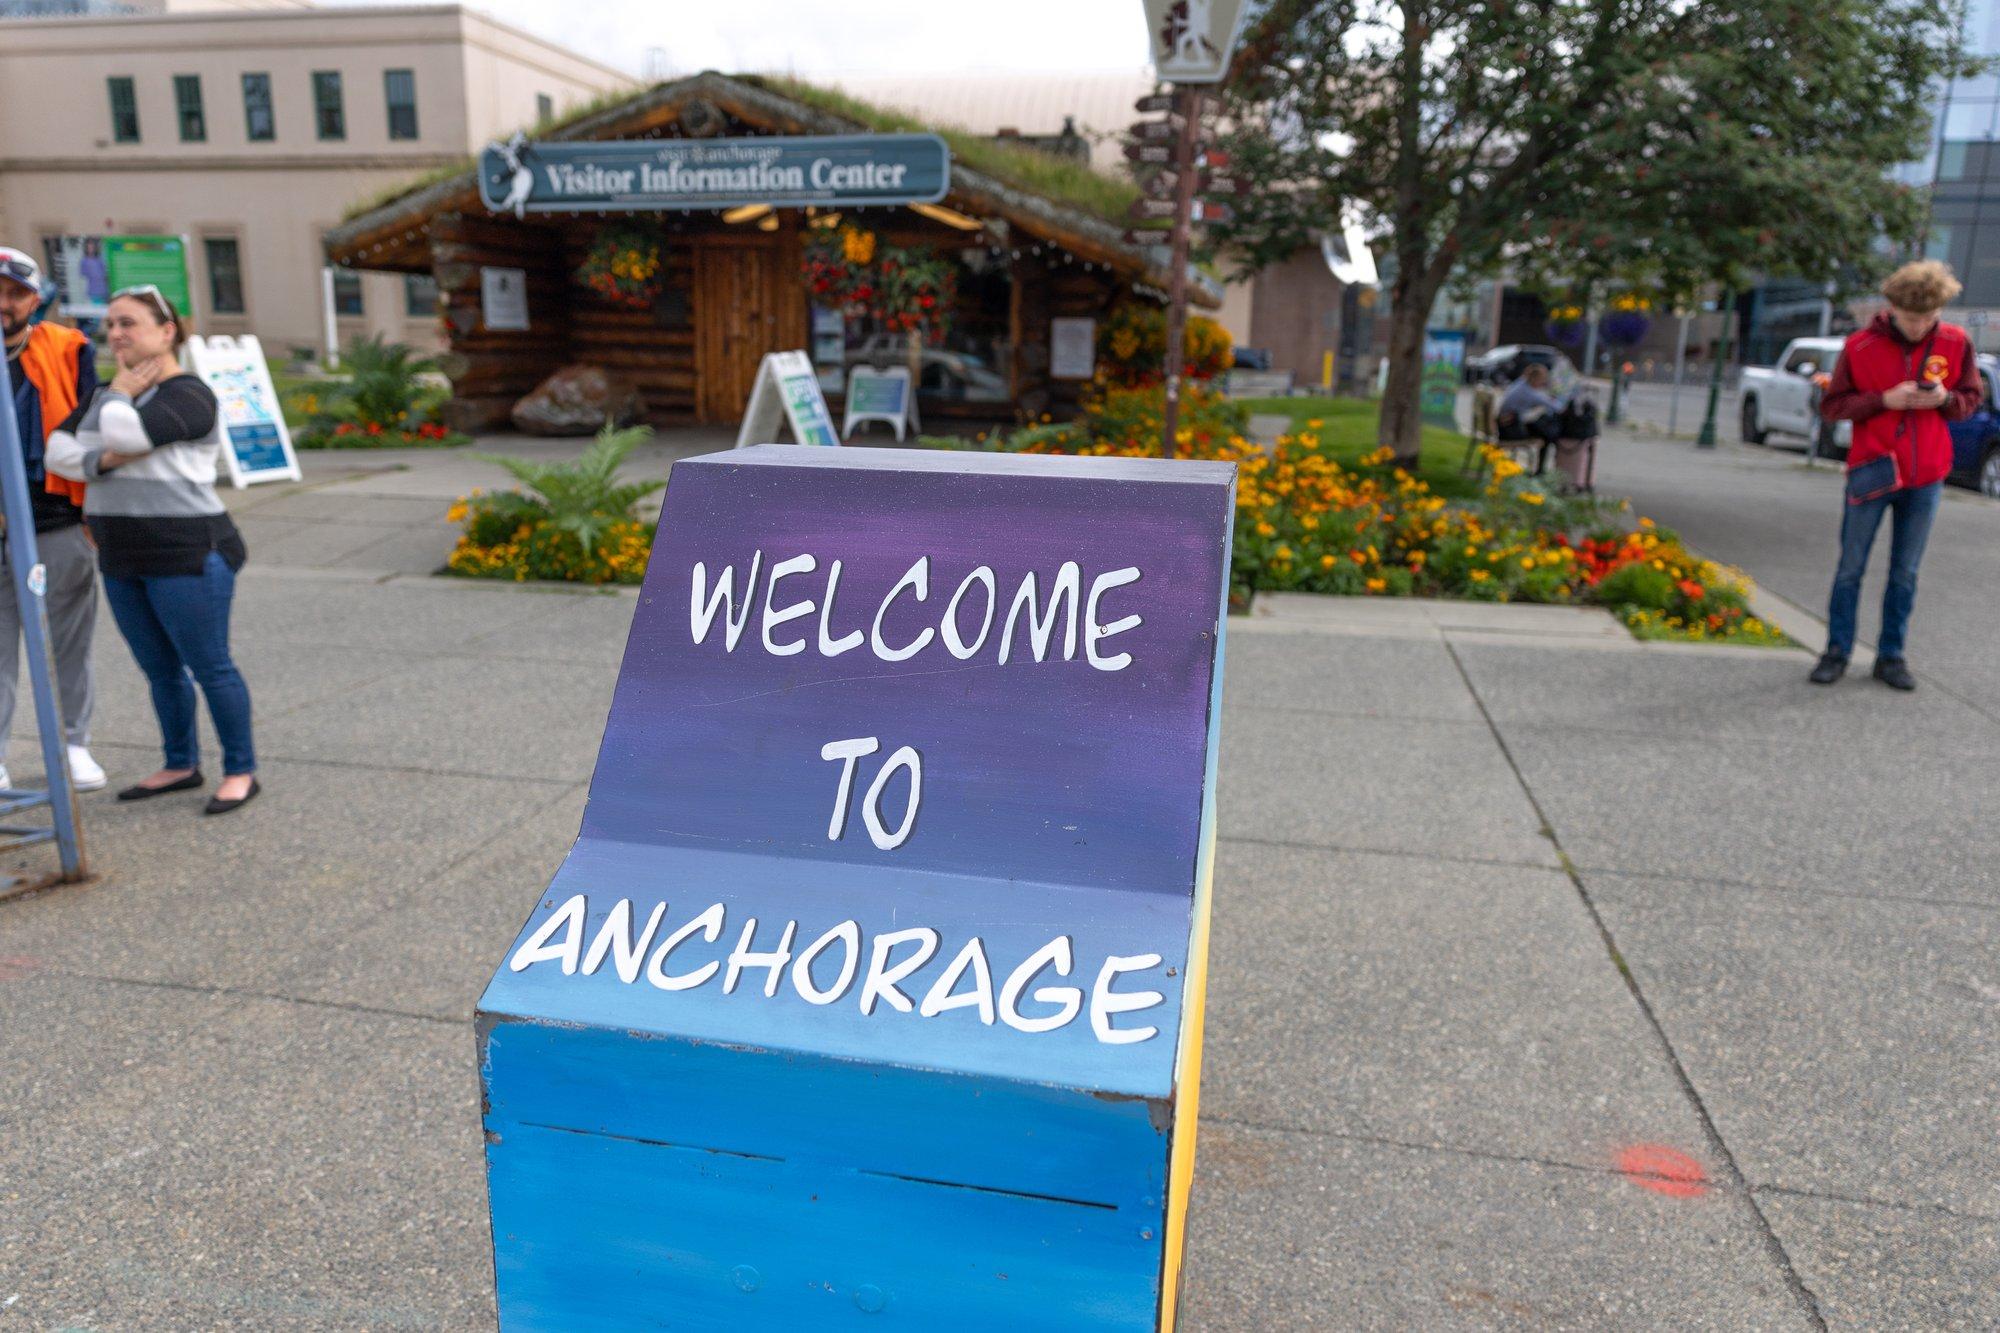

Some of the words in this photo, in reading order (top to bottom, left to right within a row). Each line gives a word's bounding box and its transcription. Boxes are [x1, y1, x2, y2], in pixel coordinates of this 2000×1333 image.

[545, 163, 635, 194] Visitor
[641, 158, 804, 193] Information
[809, 157, 908, 189] Center
[690, 549, 1142, 671] WELCOME
[820, 736, 921, 851] TO
[510, 894, 1163, 1044] ANCHORAGE
